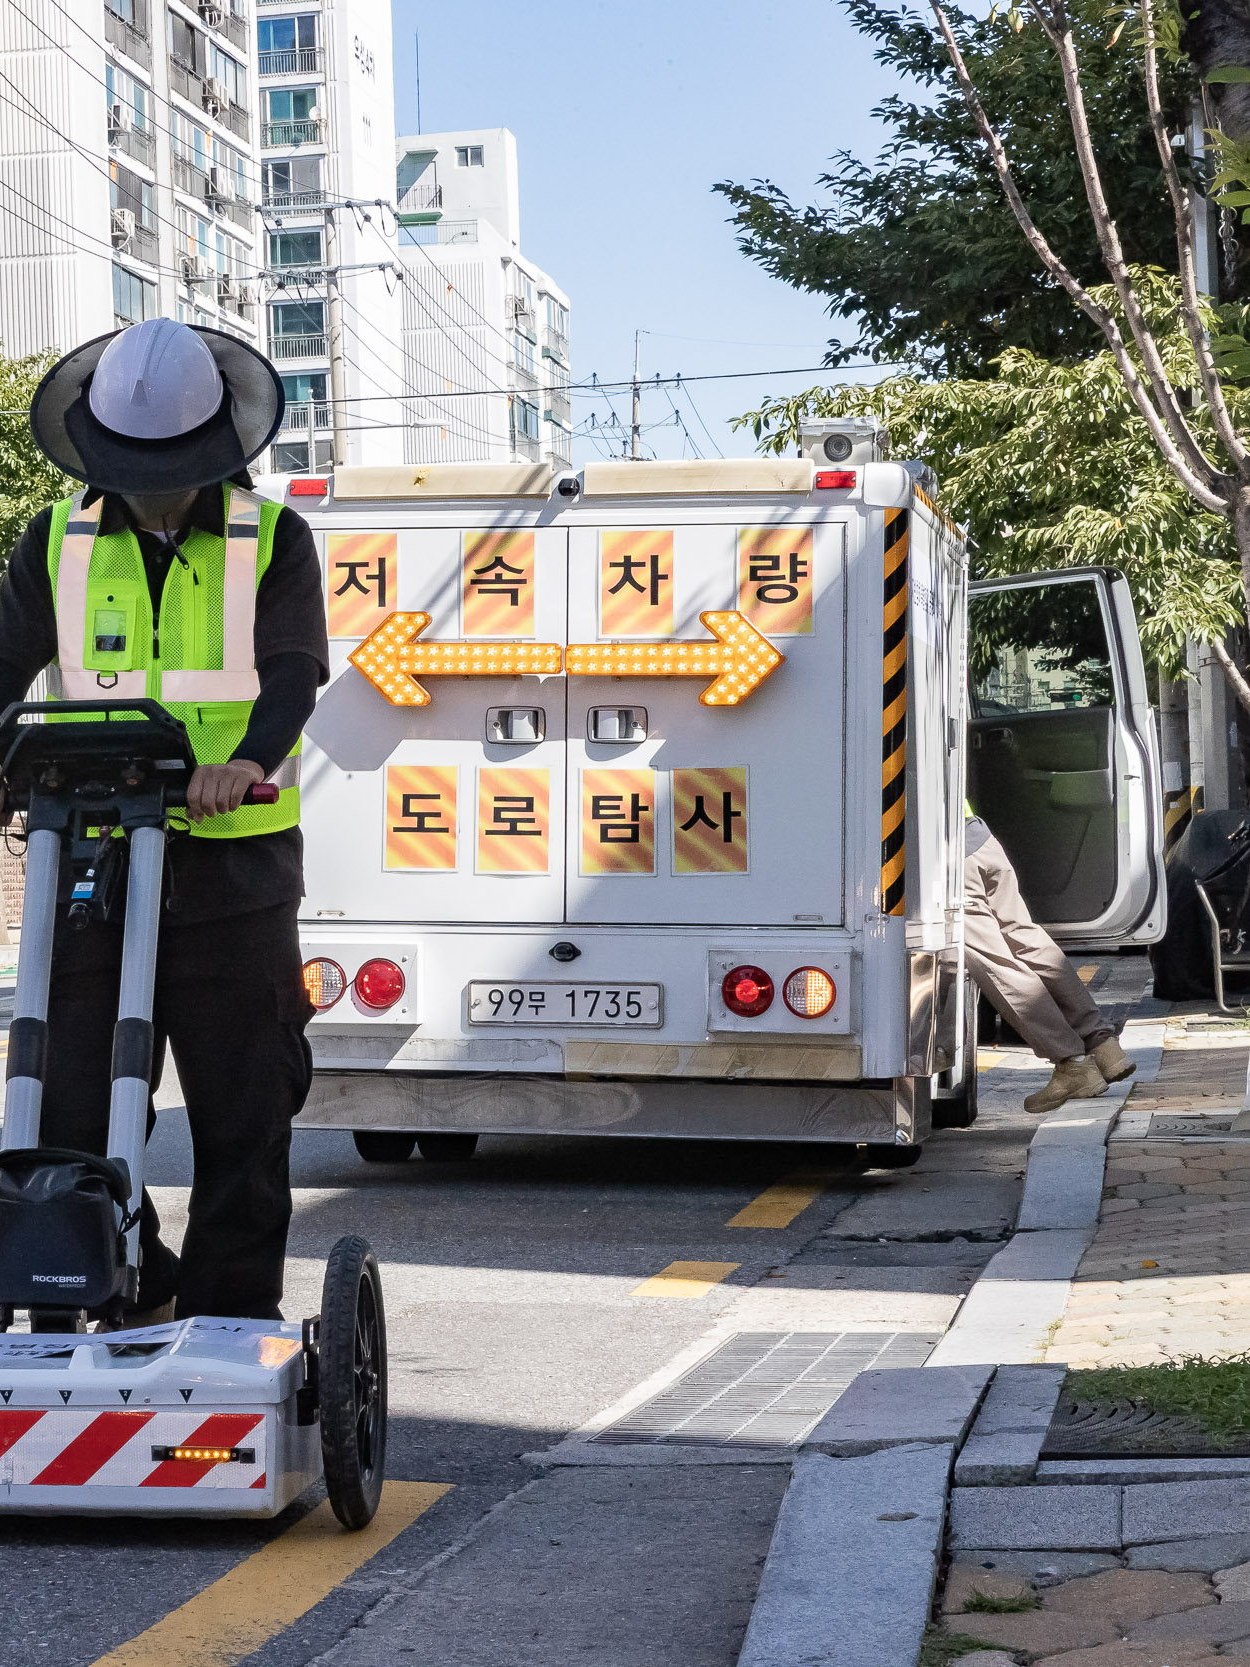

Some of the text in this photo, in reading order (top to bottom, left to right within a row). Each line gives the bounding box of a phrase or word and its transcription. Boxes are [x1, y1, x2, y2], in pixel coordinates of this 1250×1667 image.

[392, 791, 742, 844] 도로탐사
[488, 988, 642, 1019] 99무 1735
[32, 1274, 87, 1283] ROCKBROS
